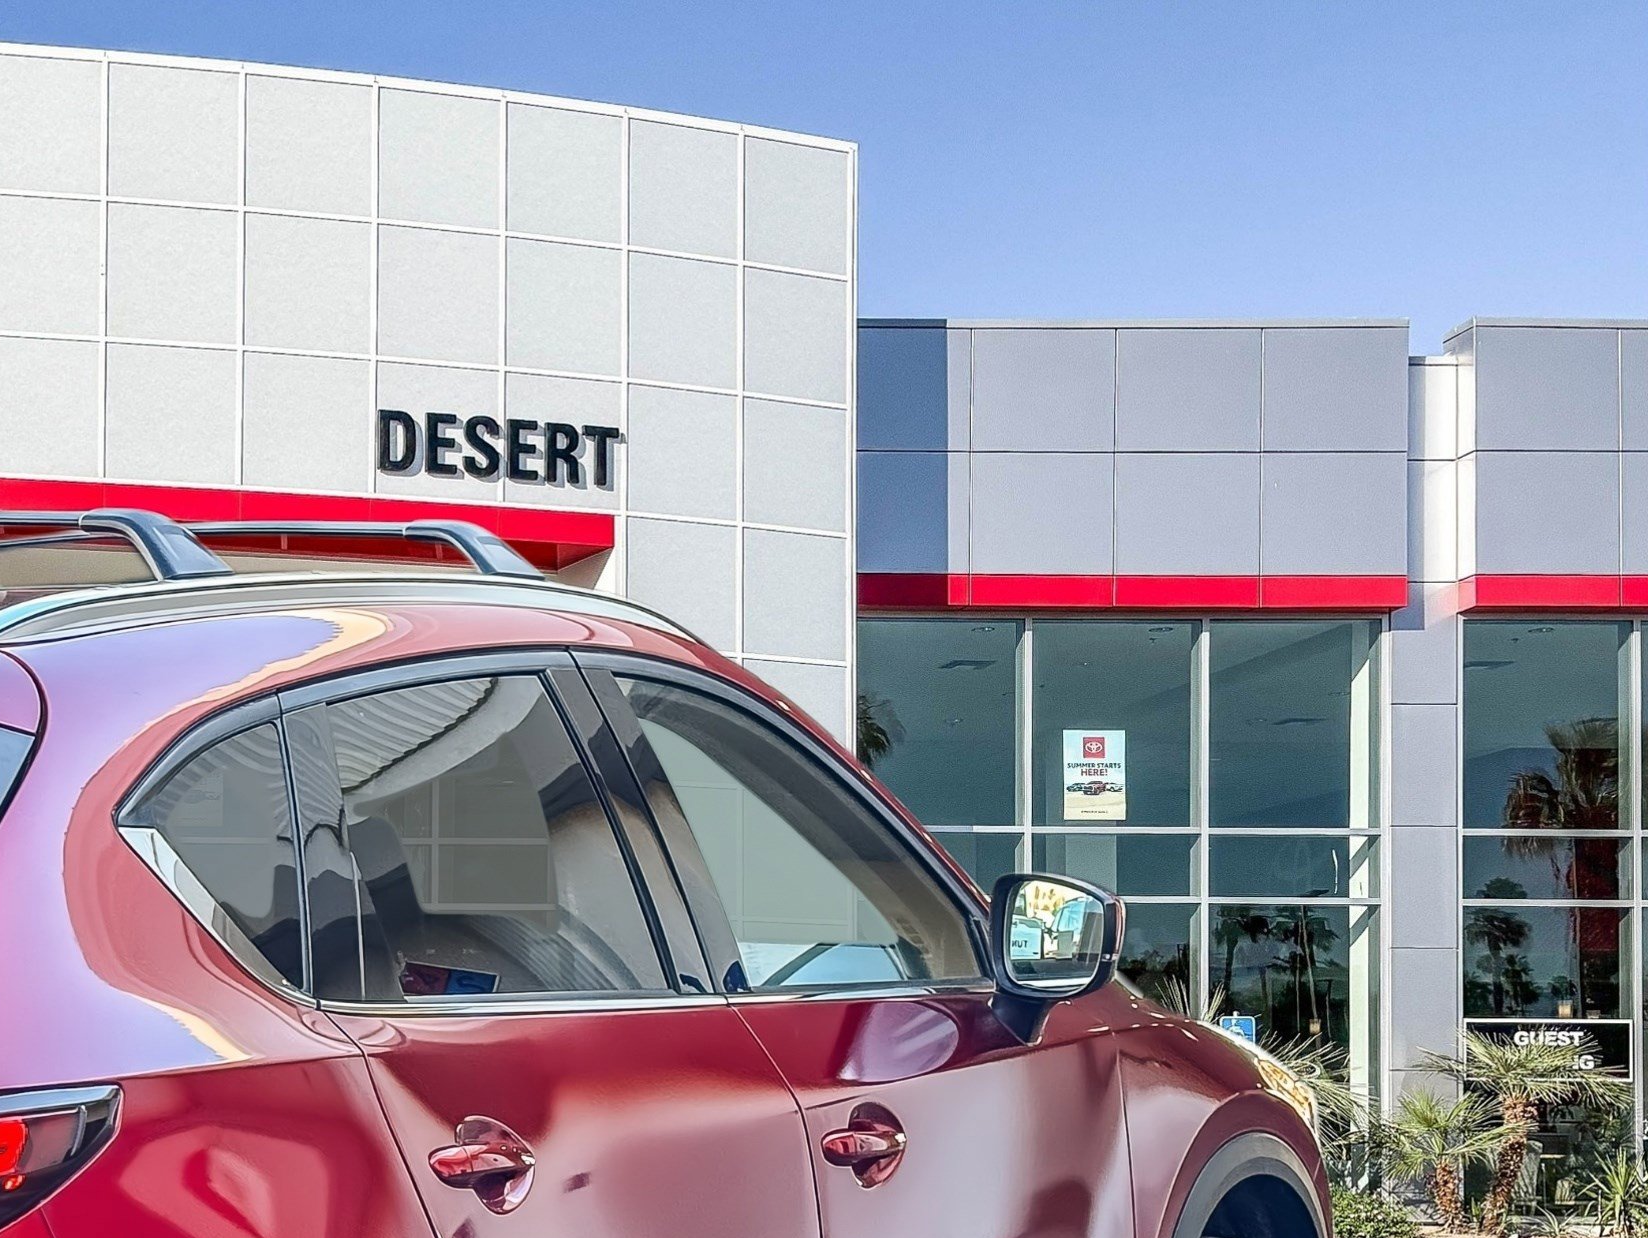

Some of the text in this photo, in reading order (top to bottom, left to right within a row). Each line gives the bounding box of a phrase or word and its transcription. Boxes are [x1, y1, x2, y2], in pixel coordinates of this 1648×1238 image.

[377, 409, 620, 487] DESERT
[1080, 769, 1108, 777] HERE!
[1513, 1031, 1584, 1047] GUEST
